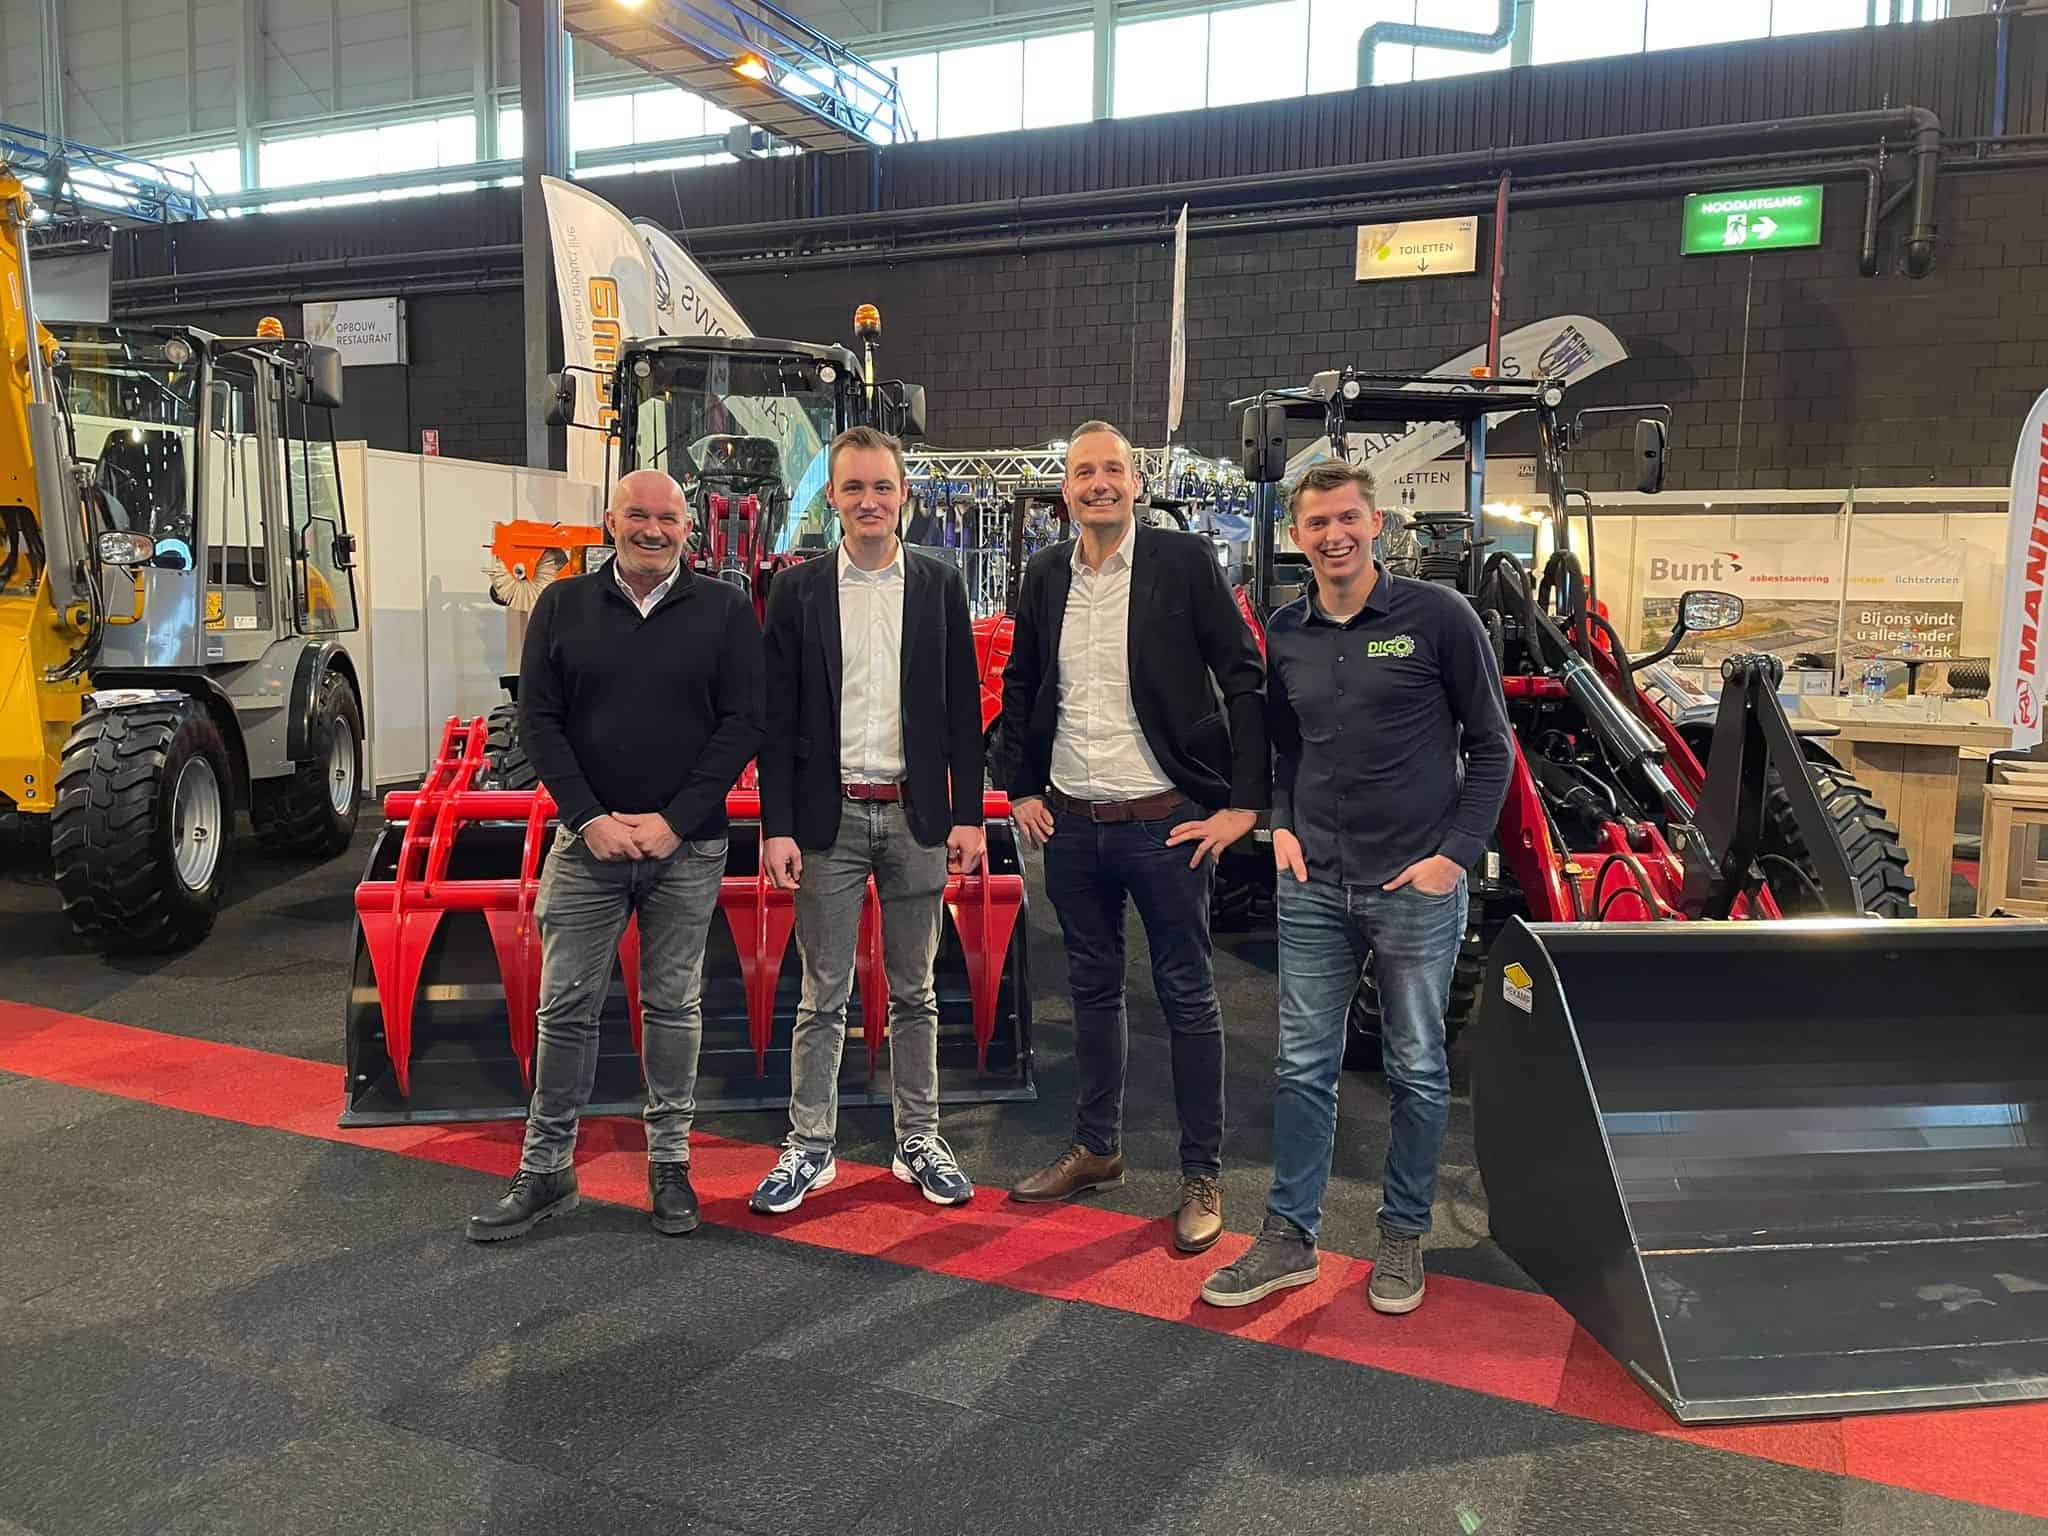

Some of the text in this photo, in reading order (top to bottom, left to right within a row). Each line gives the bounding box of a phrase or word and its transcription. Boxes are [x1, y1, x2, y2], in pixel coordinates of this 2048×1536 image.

[1701, 195, 1803, 215] NOODUITGANG
[1400, 242, 1454, 255] TOILETTEN
[336, 320, 376, 333] OPBOUW
[336, 333, 392, 345] RESTAURANT
[1393, 470, 1450, 485] LETTEN
[1650, 558, 1723, 582] Bunt
[1750, 575, 1830, 584] asbestsanering
[1895, 575, 1960, 585] lichtstraten
[1861, 611, 1955, 627] Bij ons vindt
[1856, 628, 1954, 642] u alles nder
[1924, 646, 1953, 658] dak
